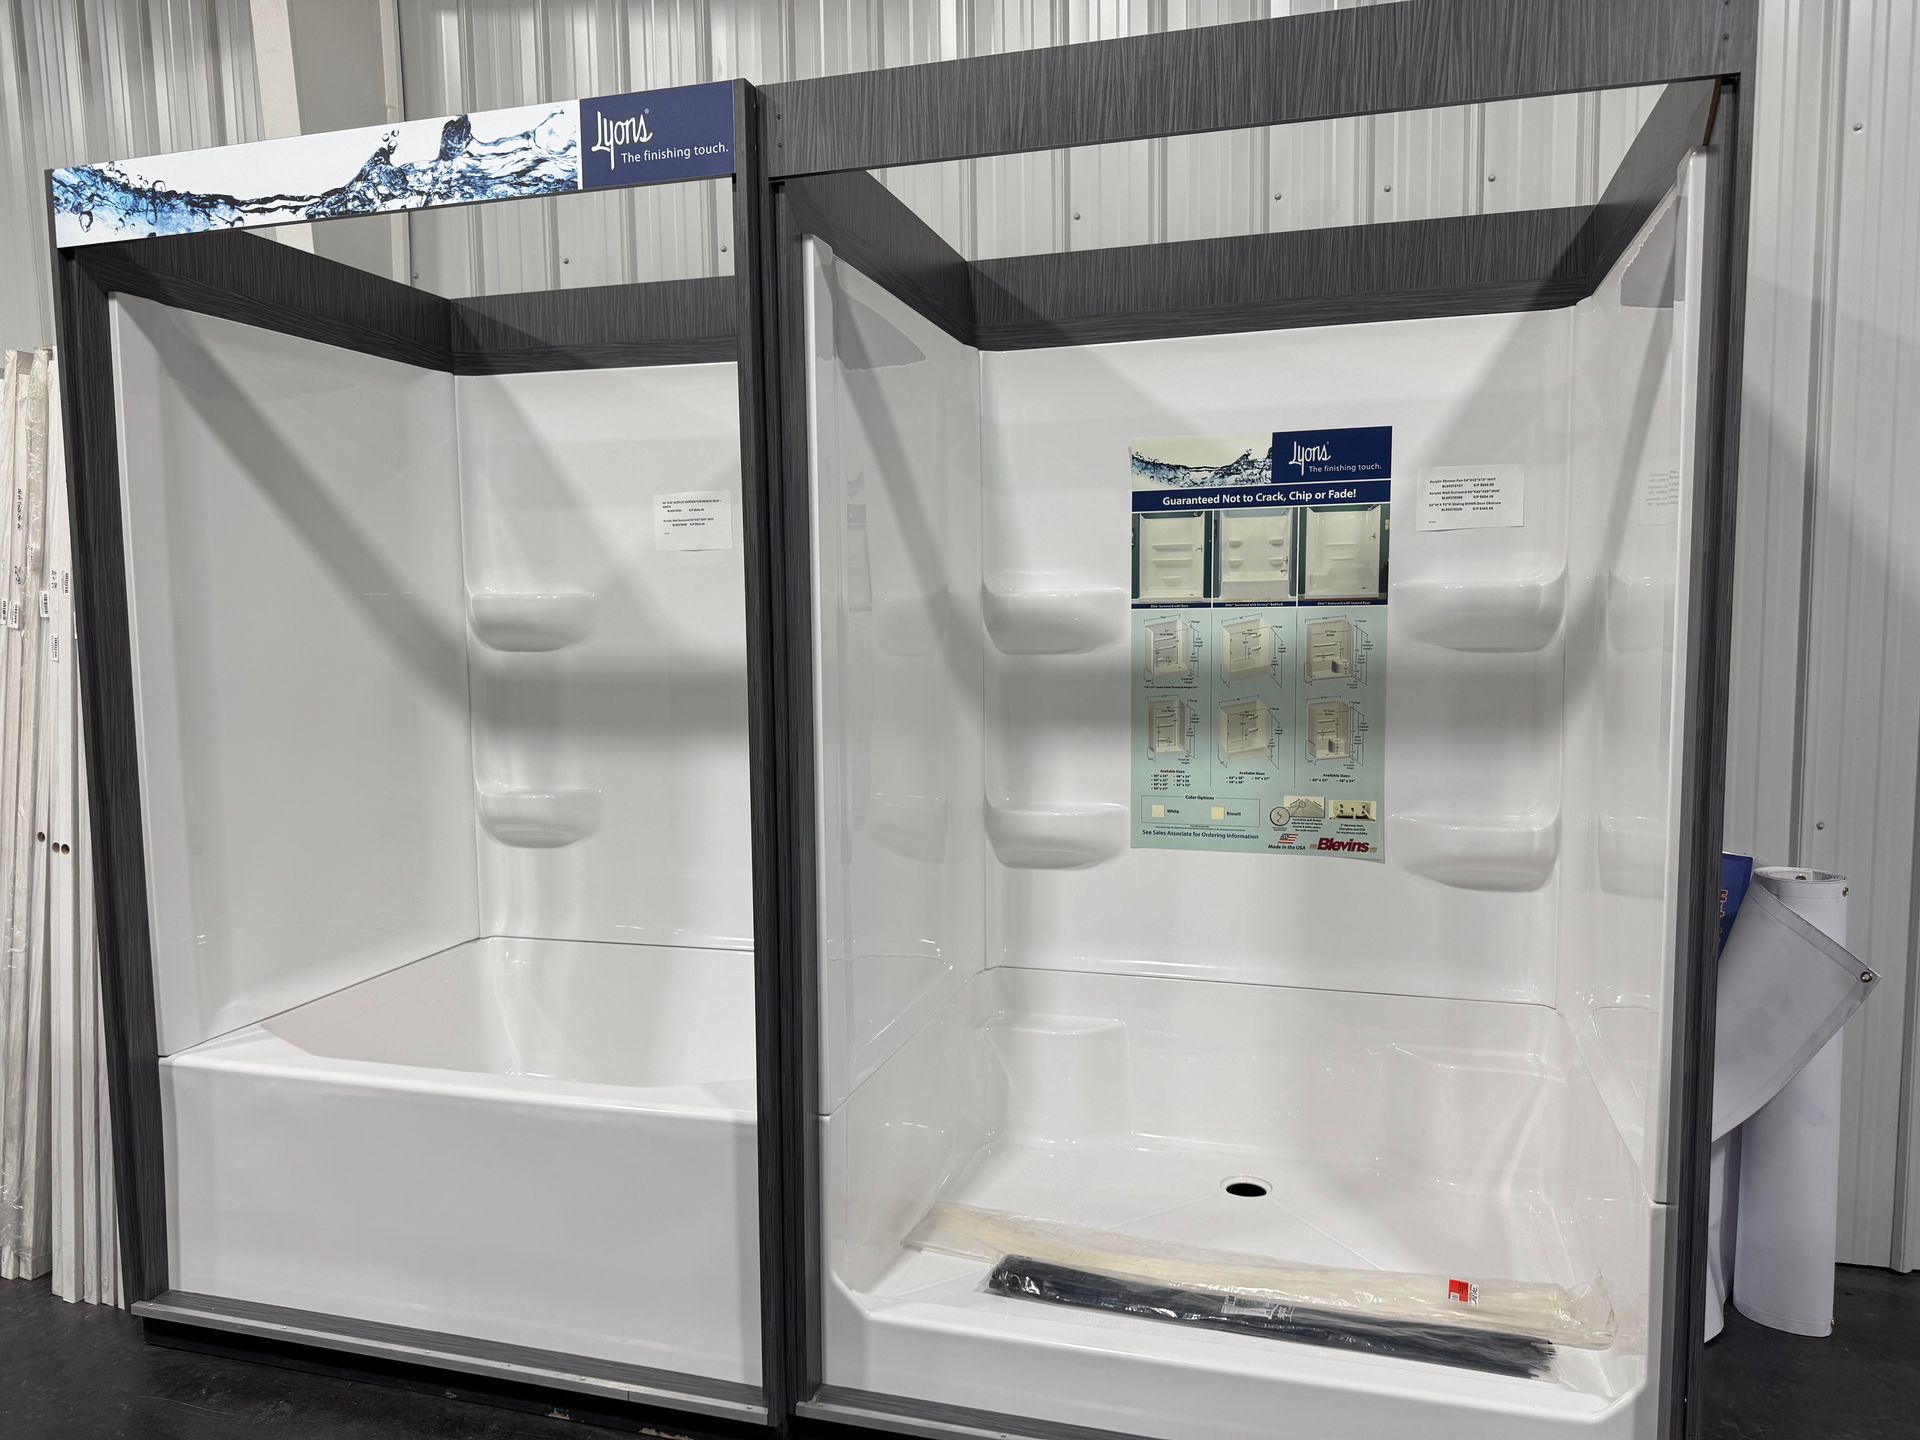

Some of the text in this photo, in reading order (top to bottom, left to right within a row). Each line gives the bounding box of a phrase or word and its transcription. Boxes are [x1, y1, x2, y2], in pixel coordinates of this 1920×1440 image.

[621, 142, 729, 164] The finishing touch.
[1308, 462, 1382, 473] The finishing touch.
[1162, 494, 1220, 506] Guaranteed
[1222, 494, 1240, 504] Not
[1242, 494, 1253, 503] to
[1256, 492, 1287, 503] Crack,
[1289, 490, 1312, 502] Chip
[1328, 488, 1356, 498] Fade!
[1201, 831, 1226, 839] Ordering
[1317, 838, 1370, 852] Blevins
